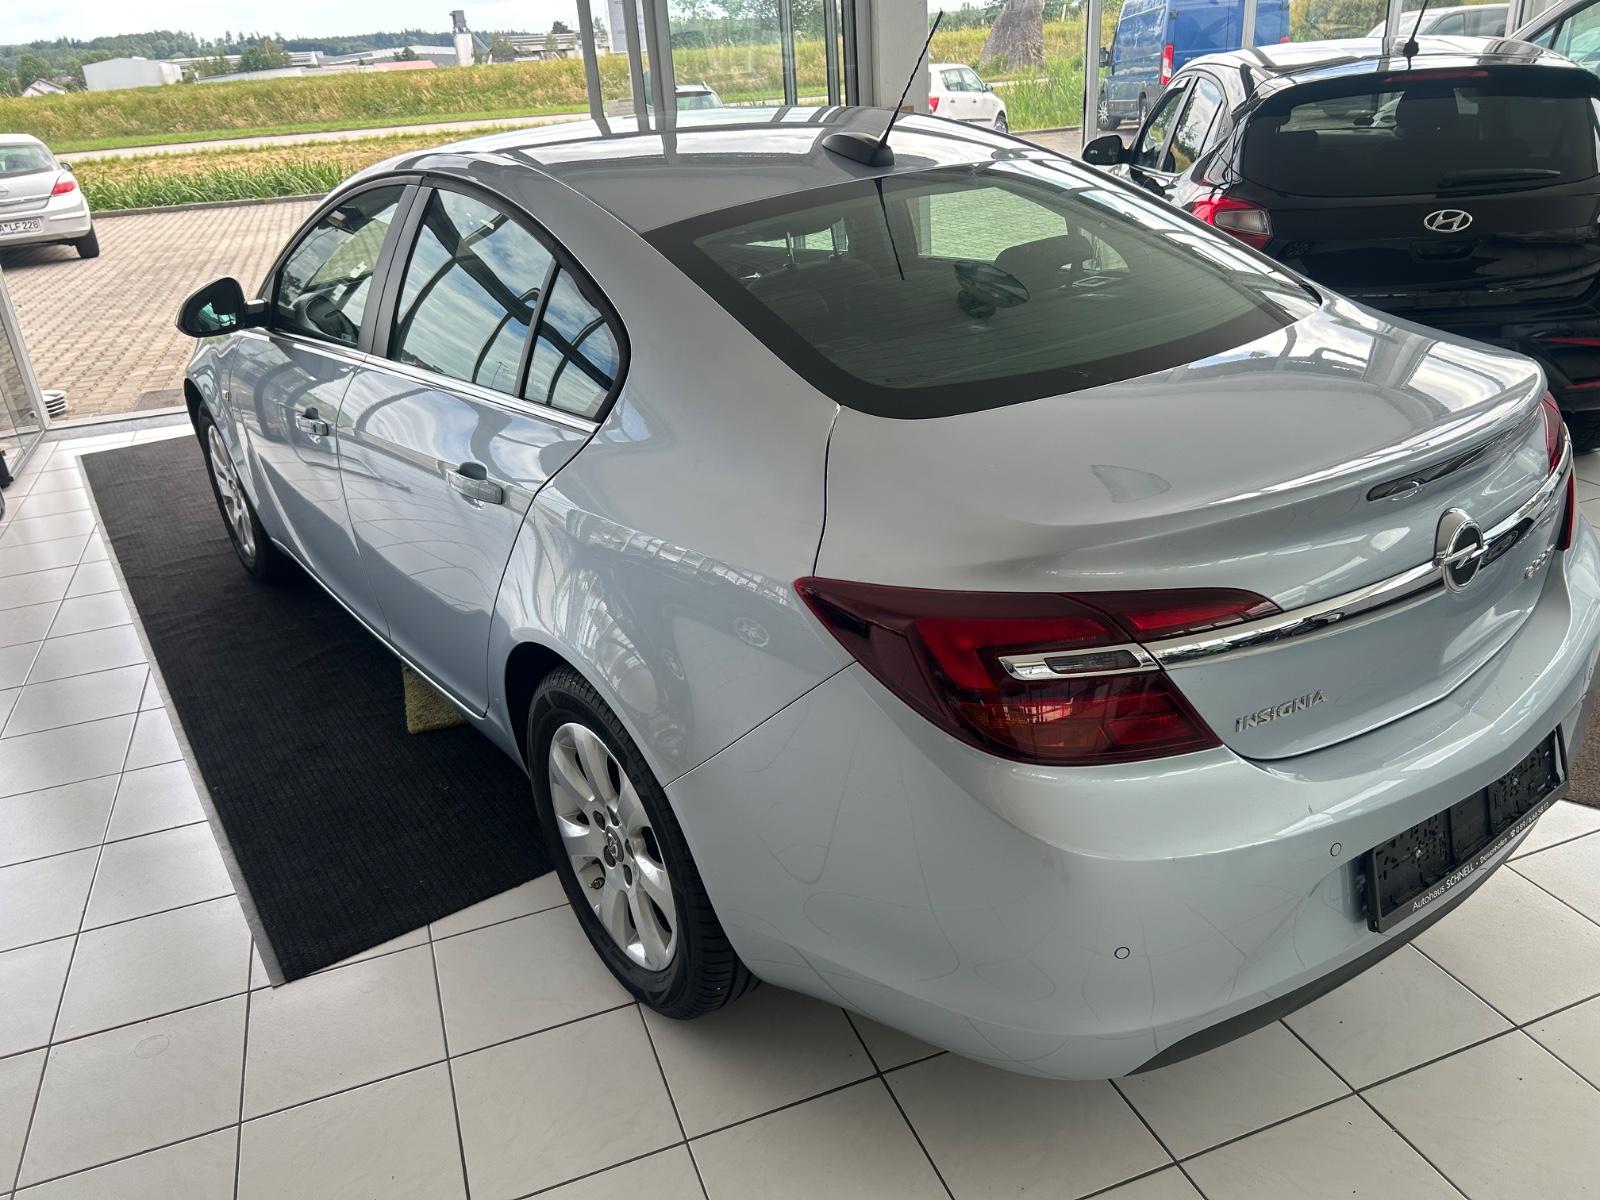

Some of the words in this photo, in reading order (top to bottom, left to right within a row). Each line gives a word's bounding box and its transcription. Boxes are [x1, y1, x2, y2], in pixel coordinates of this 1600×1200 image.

[1235, 689, 1328, 733] INSIGNIA
[1412, 885, 1445, 911] Autohaus
[1446, 863, 1474, 889] SCHNELL
